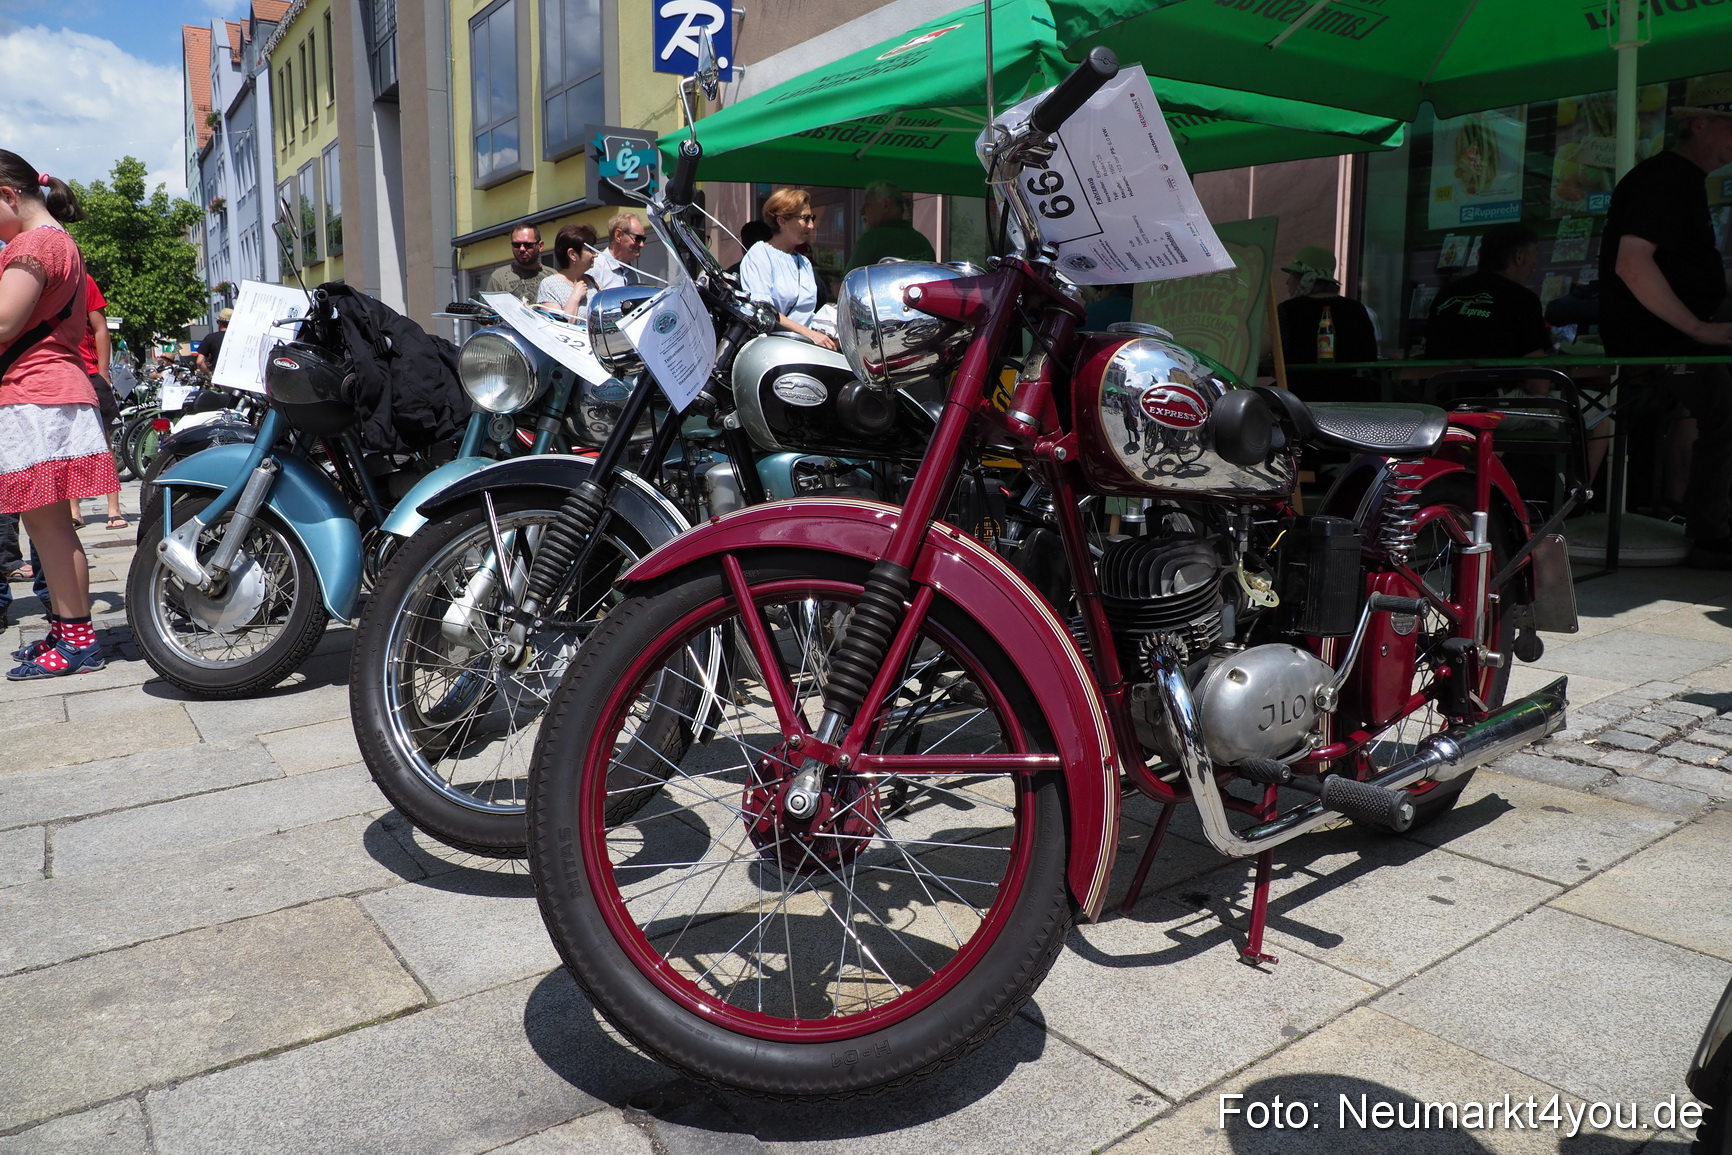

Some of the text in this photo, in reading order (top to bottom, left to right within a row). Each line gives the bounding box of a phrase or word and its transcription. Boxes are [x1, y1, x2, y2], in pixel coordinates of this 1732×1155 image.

[1130, 96, 1148, 128] NEUMARKT
[1146, 131, 1160, 154] auctores
[616, 148, 641, 179] G2
[1086, 176, 1102, 205] Fahrzeug
[1475, 203, 1519, 219] Rupprecht
[1160, 291, 1227, 317] WERKE
[1459, 301, 1491, 318] Express
[1149, 405, 1196, 422] EXPRESS
[558, 827, 585, 897] MITAS
